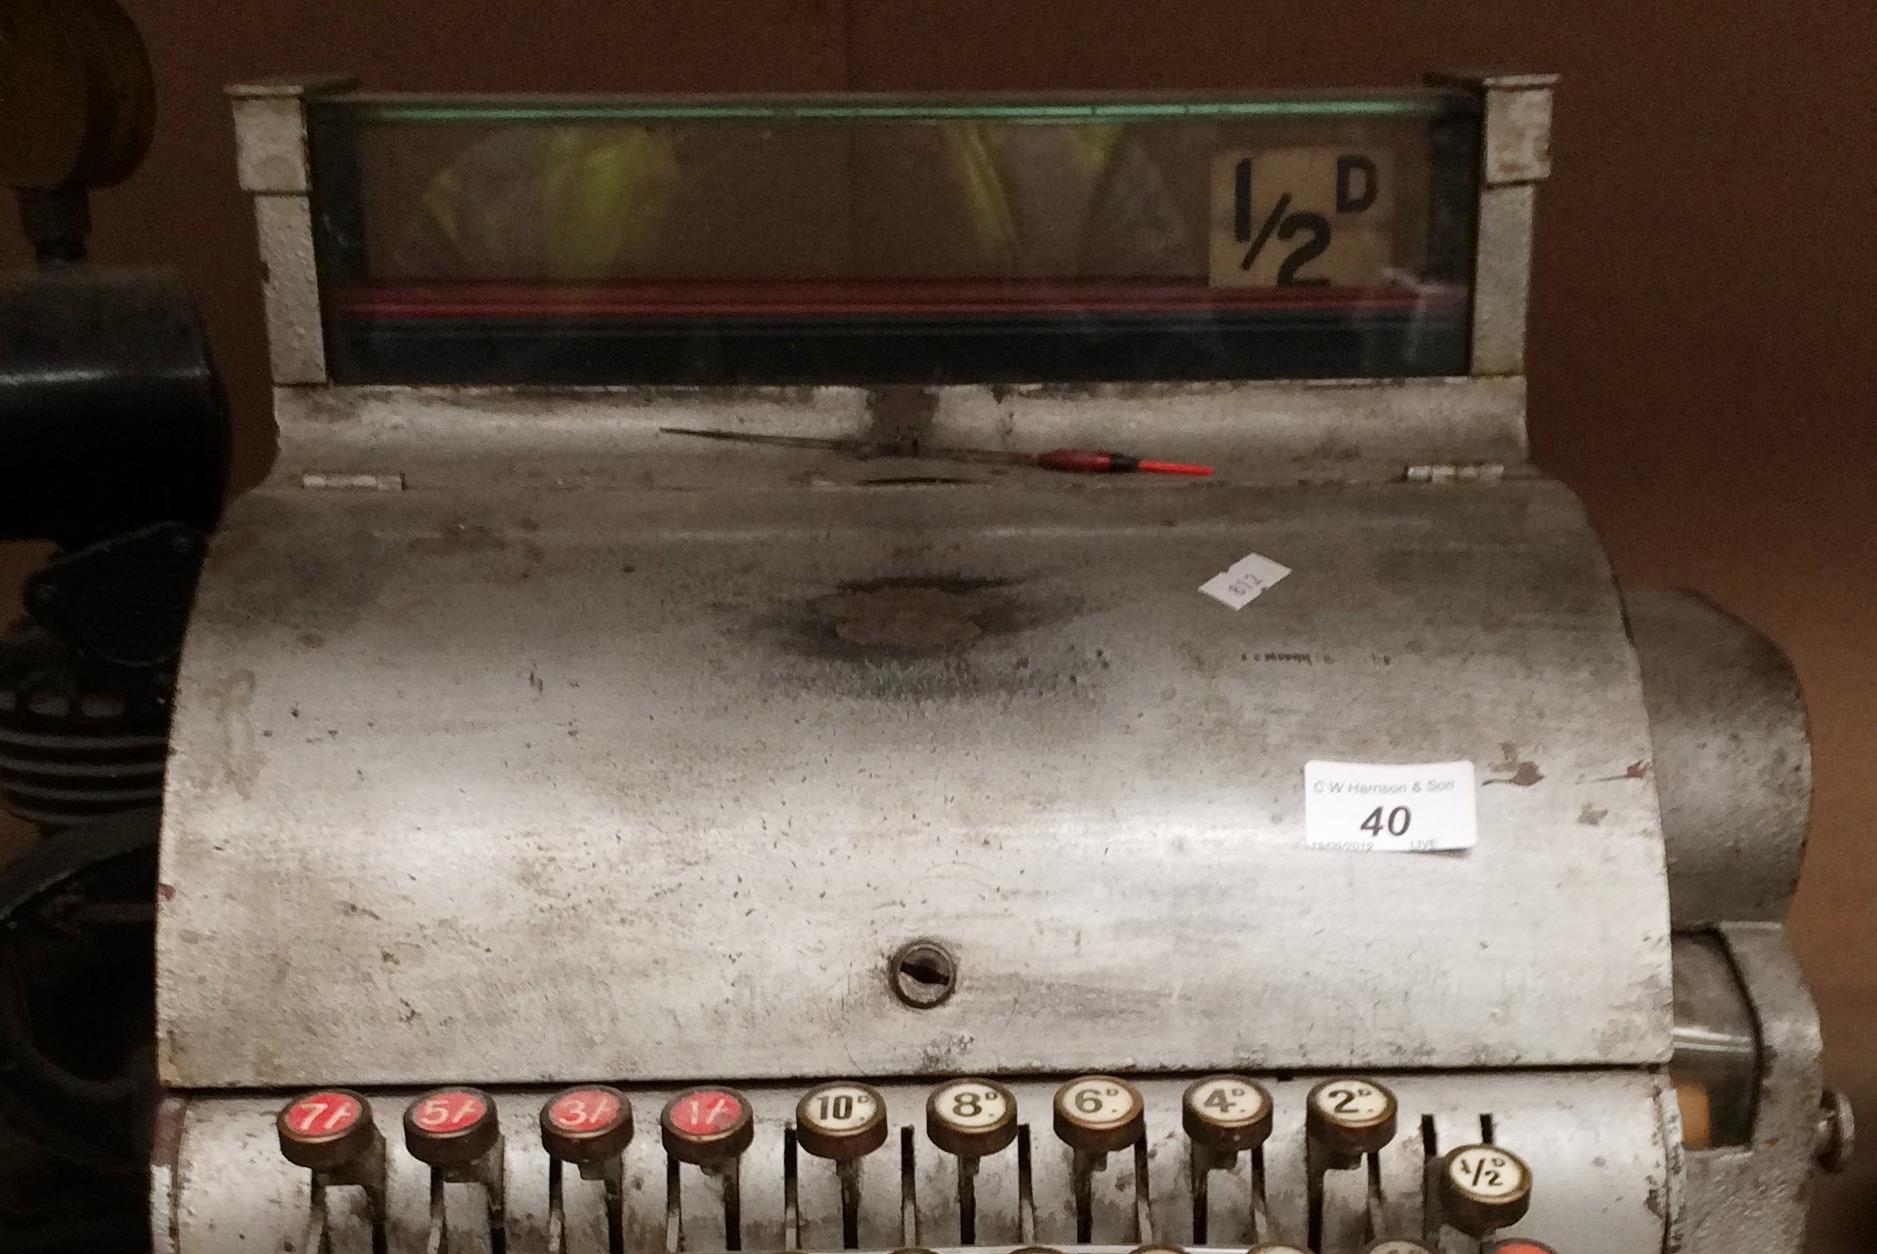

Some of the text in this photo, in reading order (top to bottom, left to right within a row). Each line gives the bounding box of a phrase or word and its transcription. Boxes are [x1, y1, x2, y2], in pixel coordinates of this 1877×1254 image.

[1313, 779, 1454, 793] C W Harrison & Son
[1360, 805, 1411, 836] 40
